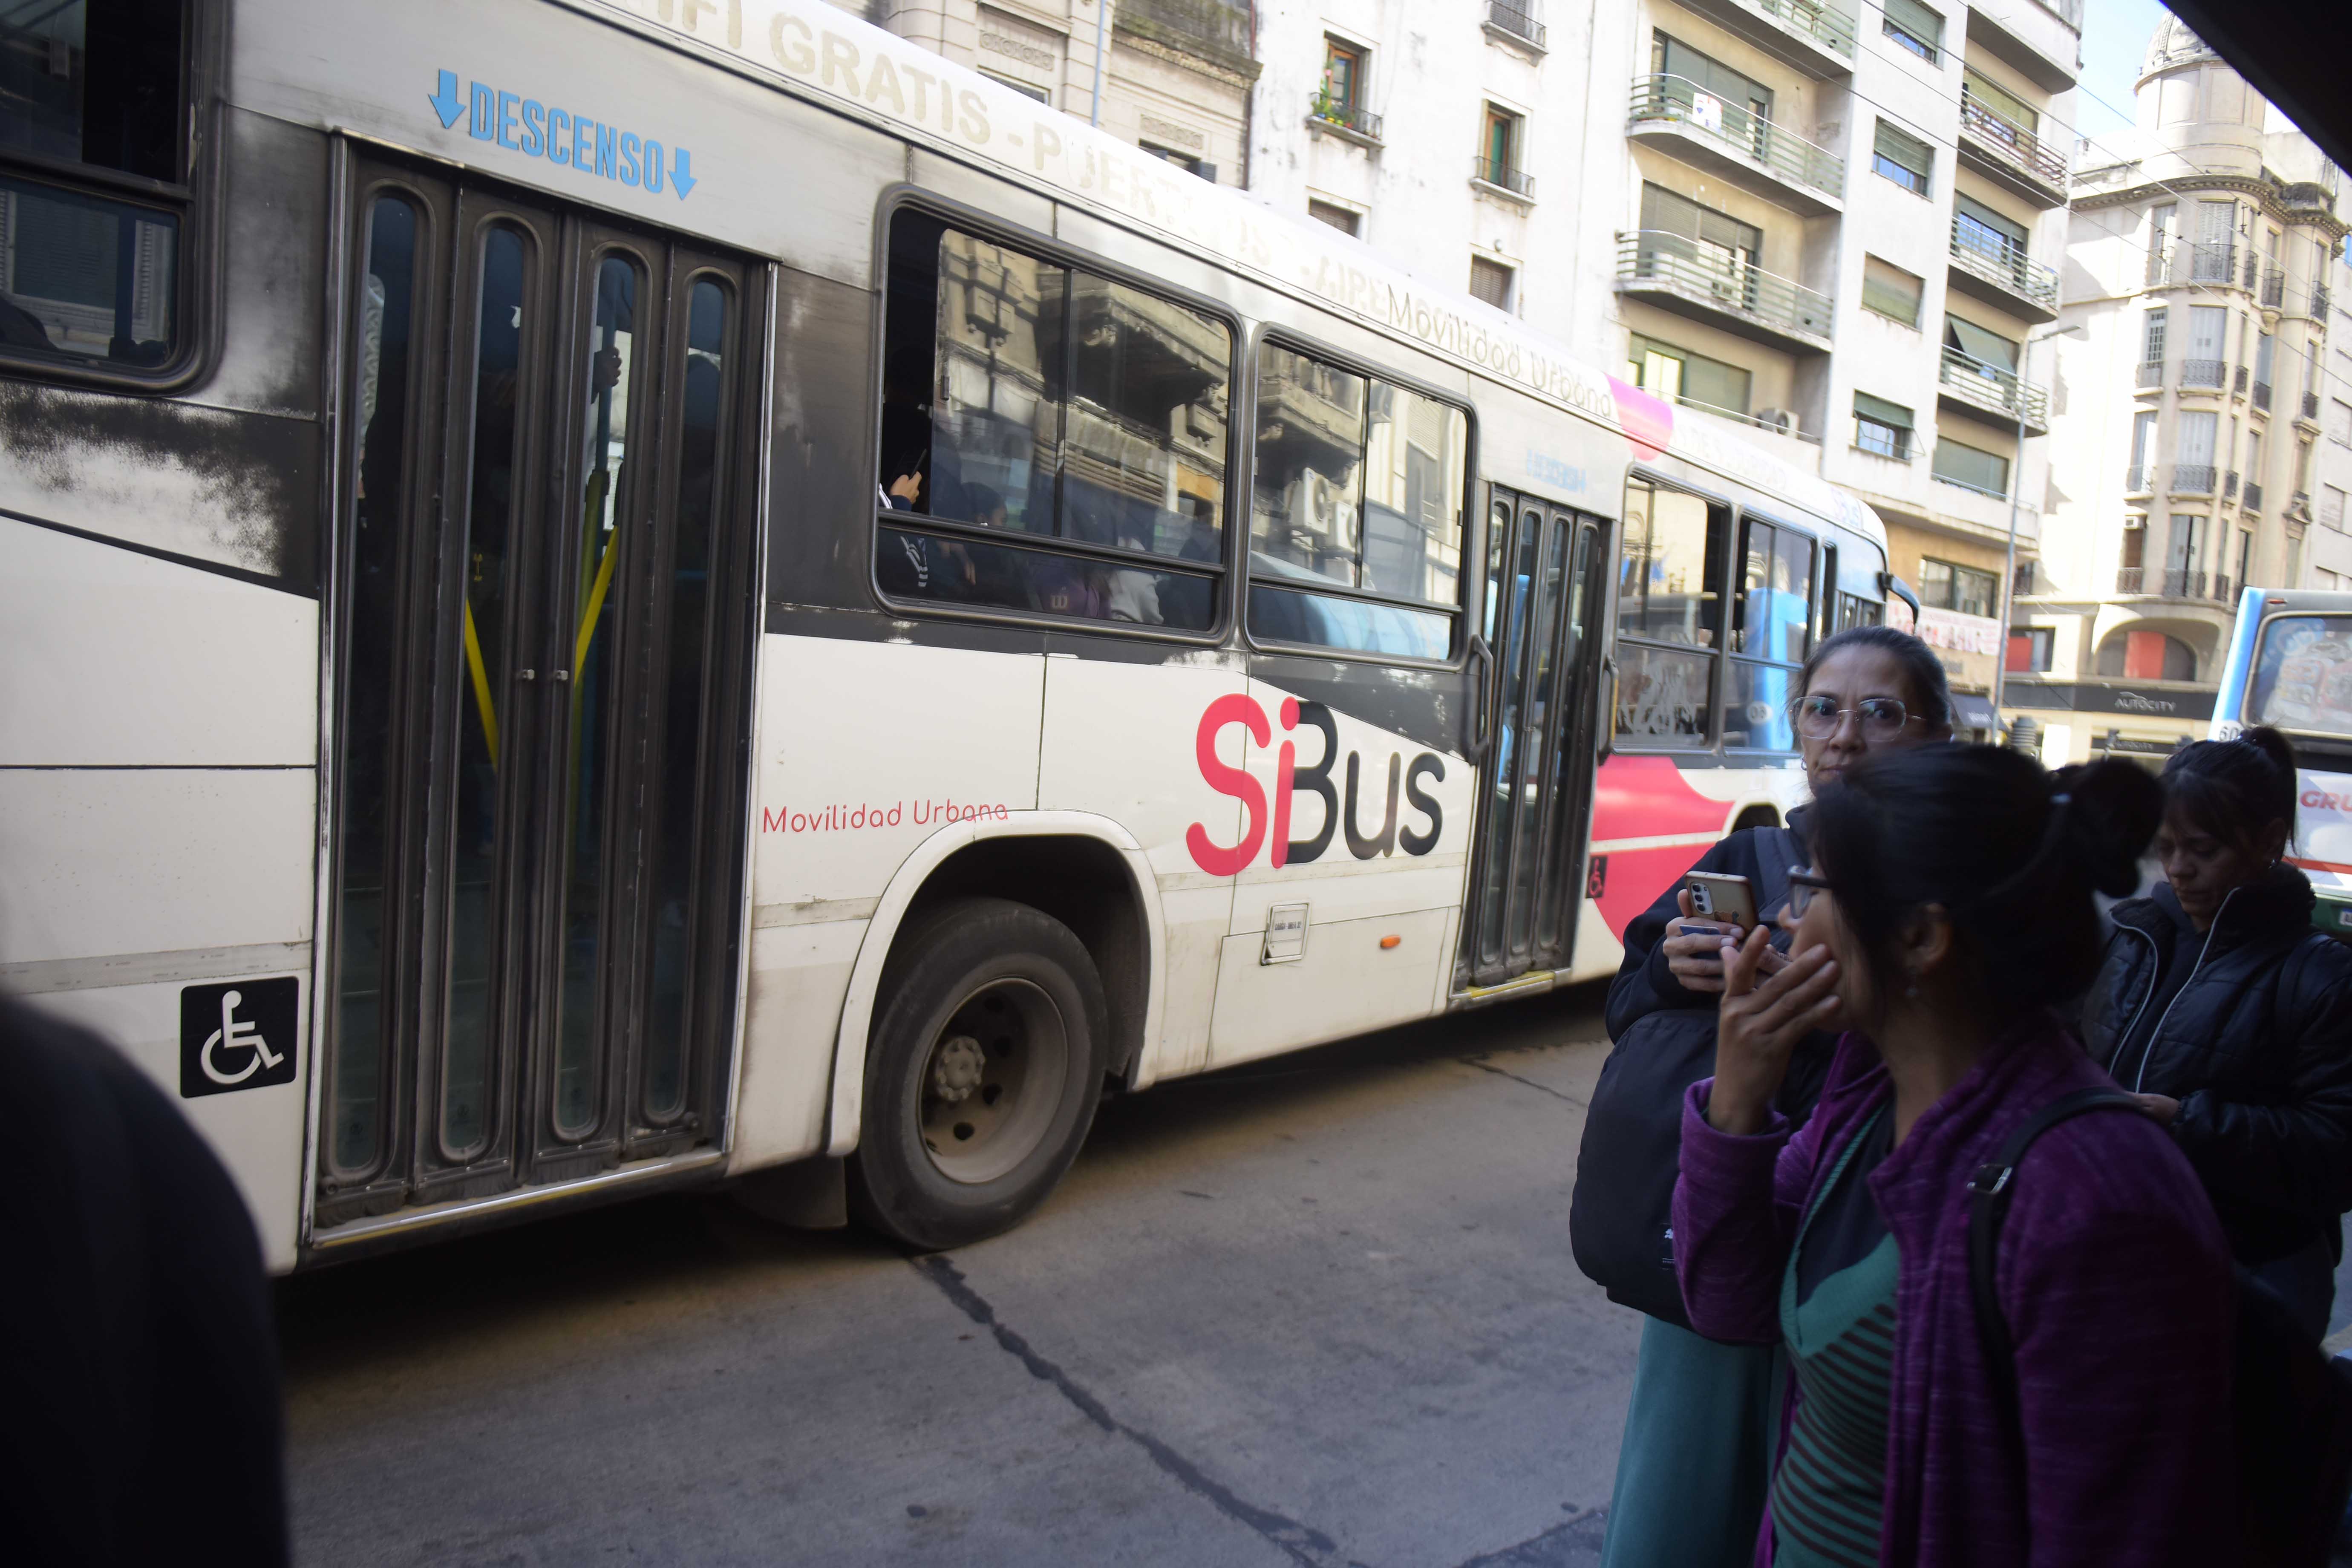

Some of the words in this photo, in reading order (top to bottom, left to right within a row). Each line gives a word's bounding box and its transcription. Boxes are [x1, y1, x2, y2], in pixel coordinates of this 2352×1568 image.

[770, 12, 991, 144] GRATIS
[470, 80, 665, 193] DESCENSO
[1386, 283, 1521, 378] Movilidad
[1531, 350, 1612, 418] Urbana
[2114, 698, 2176, 712] AUTOCITY
[763, 801, 902, 833] Movilidad
[913, 798, 1009, 824] Urbana
